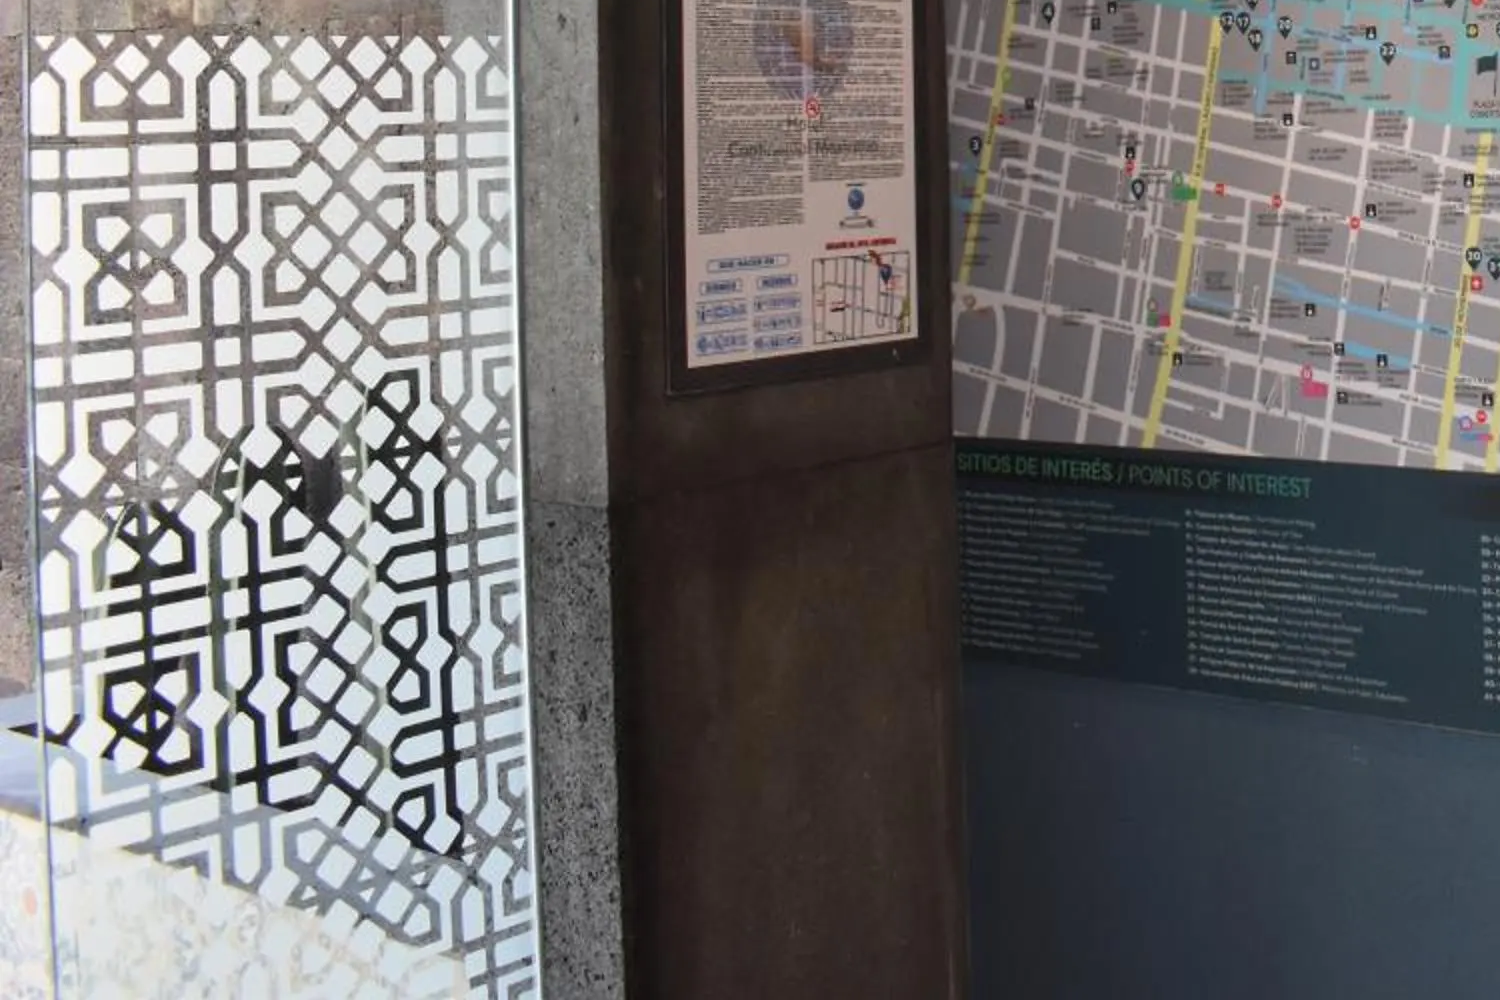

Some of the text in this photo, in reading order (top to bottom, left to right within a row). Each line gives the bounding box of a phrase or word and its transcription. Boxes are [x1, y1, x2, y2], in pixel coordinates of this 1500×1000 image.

[957, 452, 1011, 473] SITIOS
[1014, 456, 1037, 475] DE
[1043, 457, 1114, 482] INTERÉS
[1129, 465, 1193, 488] POINTS
[1197, 469, 1221, 490] OF
[1228, 471, 1312, 498] INTEREST
